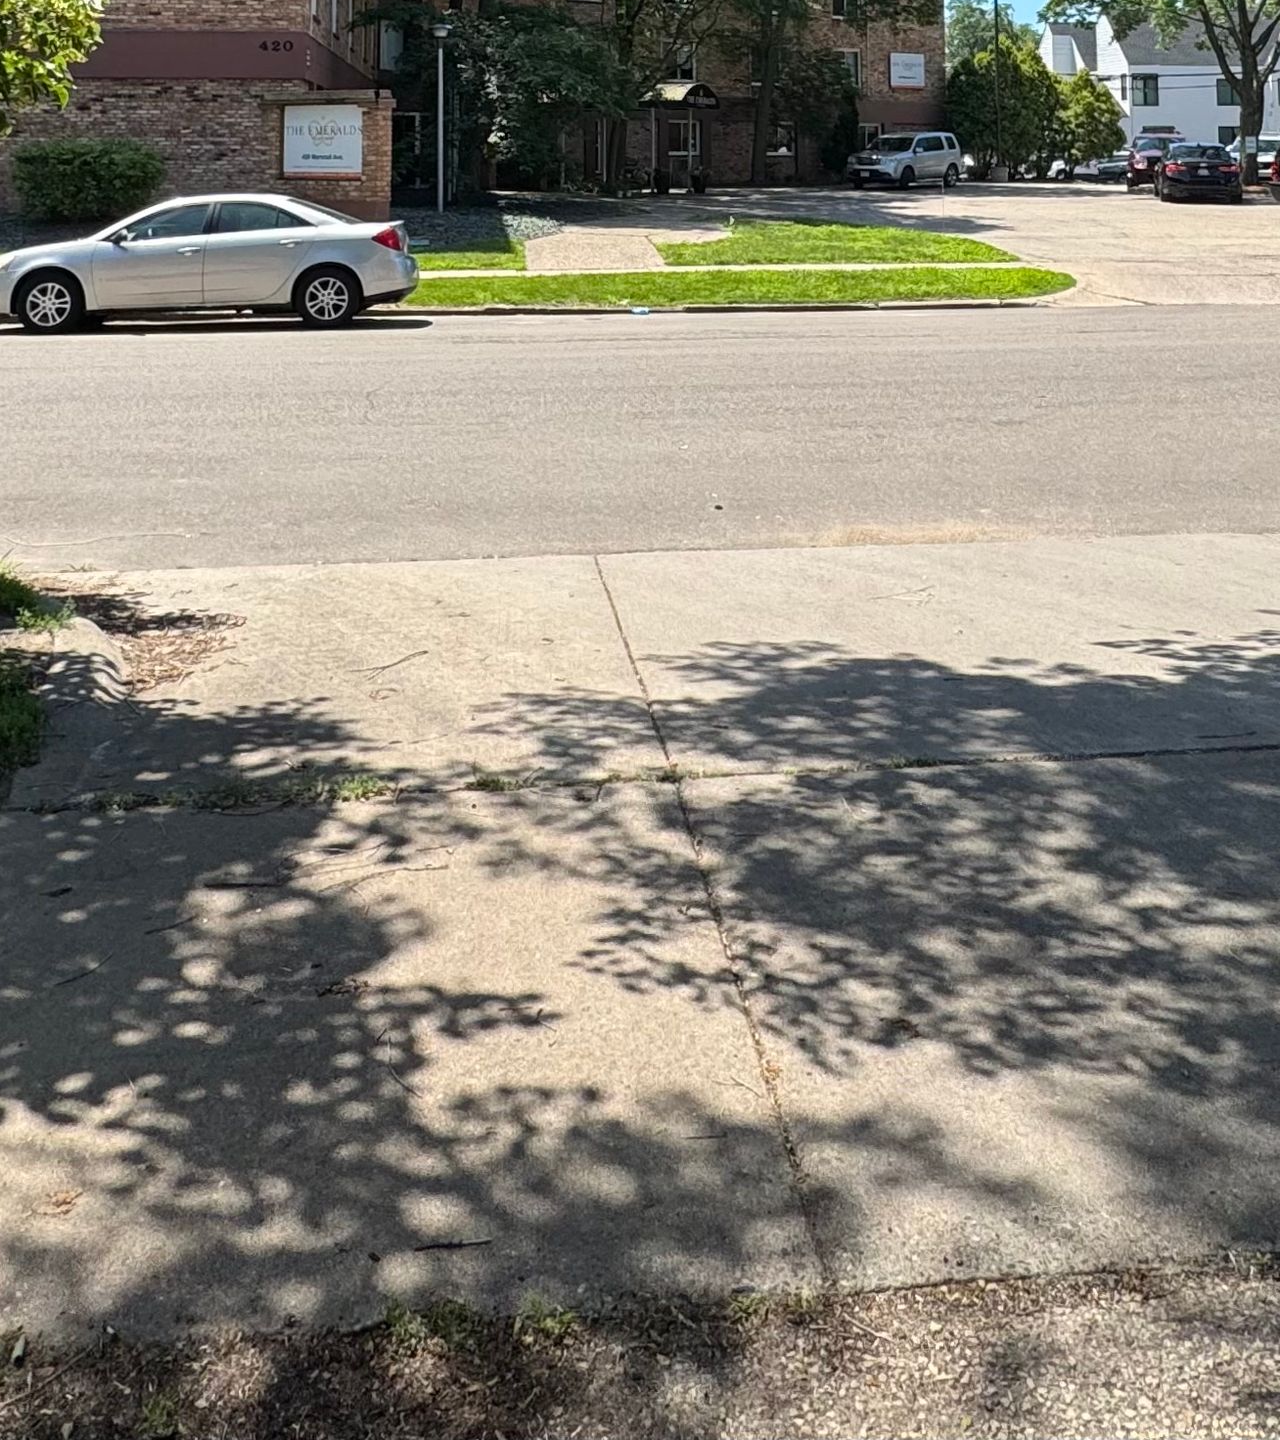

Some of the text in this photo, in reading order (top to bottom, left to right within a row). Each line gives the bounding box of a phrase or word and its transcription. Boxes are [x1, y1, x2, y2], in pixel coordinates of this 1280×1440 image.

[258, 40, 294, 52] 420
[286, 124, 363, 136] THE EMERALDS
